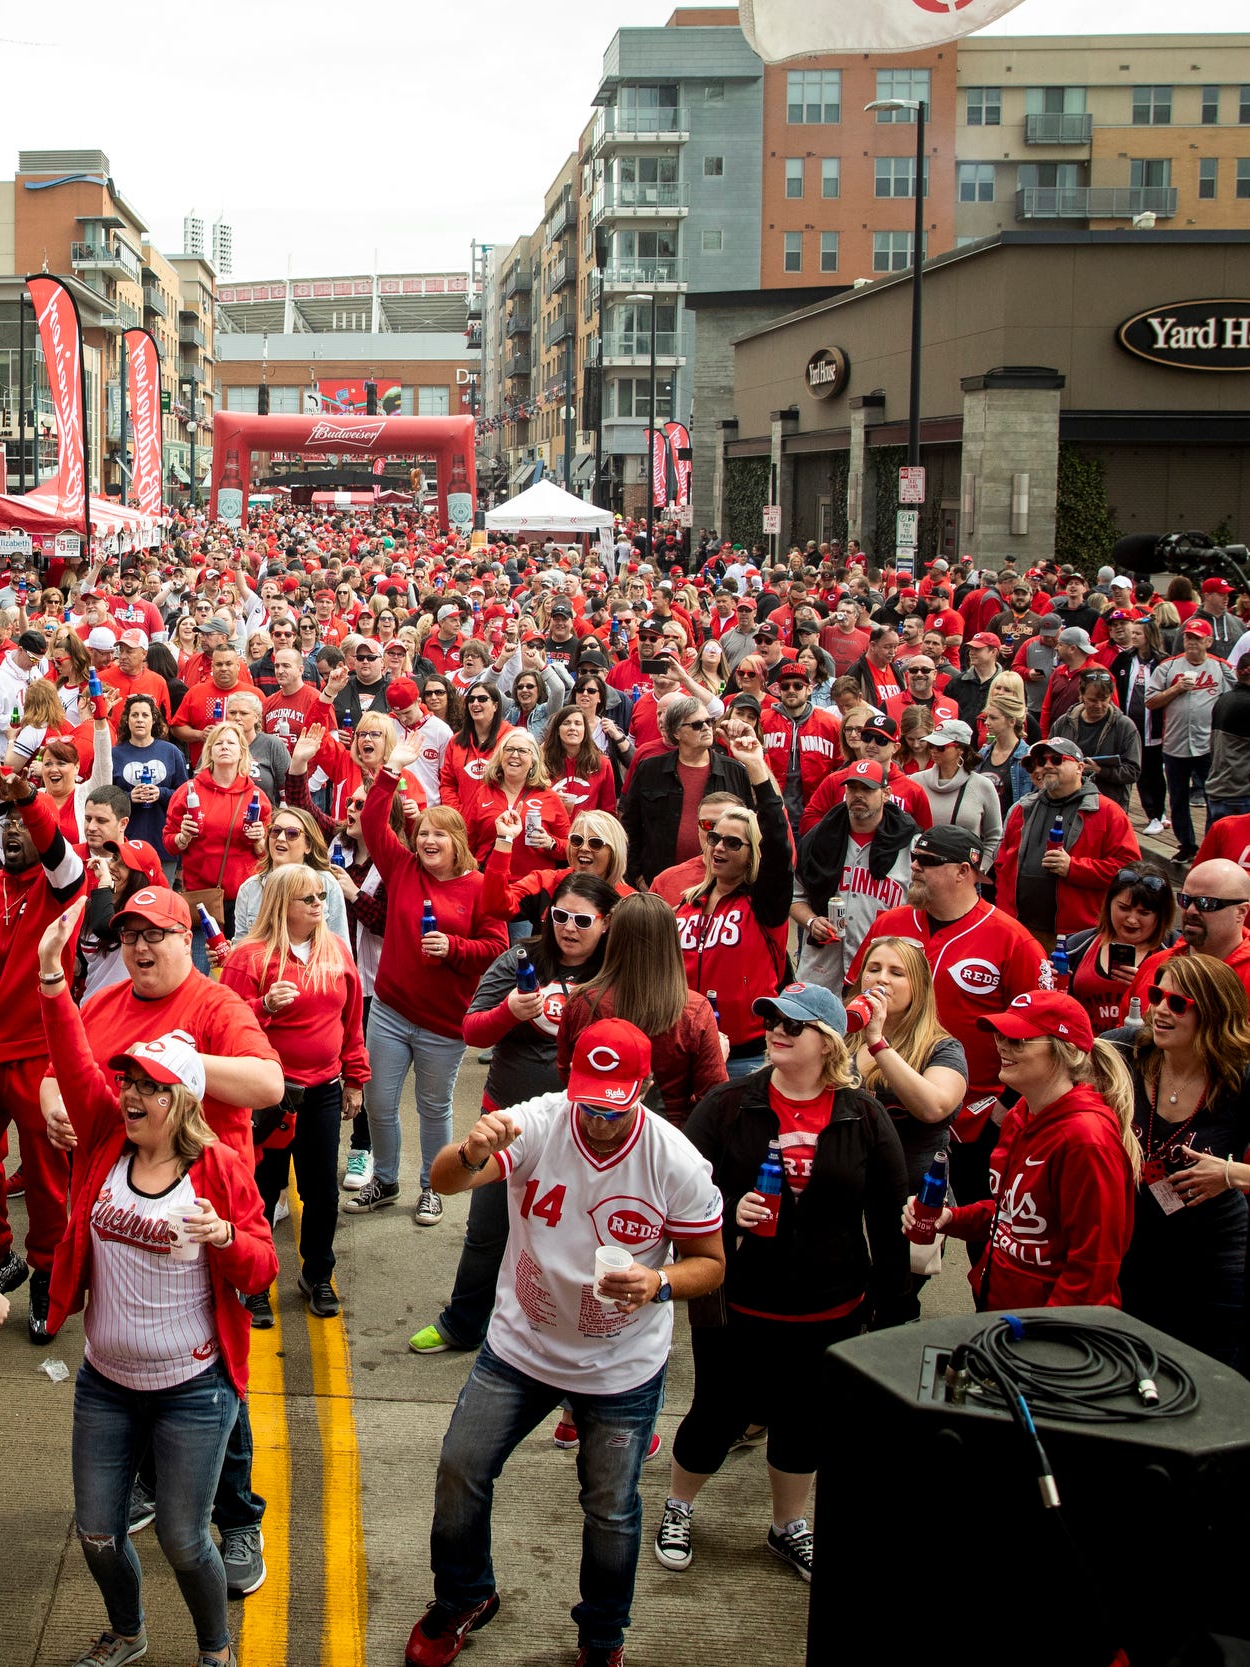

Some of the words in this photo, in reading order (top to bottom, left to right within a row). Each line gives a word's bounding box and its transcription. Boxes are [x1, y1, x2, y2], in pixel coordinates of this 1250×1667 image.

[1147, 317, 1217, 349] Yard
[1221, 317, 1250, 349] H
[809, 361, 821, 385] Yard
[820, 360, 837, 382] House
[131, 338, 162, 516] Budweiser
[313, 425, 378, 441] Budweiser
[549, 651, 571, 660] EDS
[877, 684, 901, 700] RED
[962, 967, 1001, 986] REDS
[1099, 1005, 1120, 1018] NO
[605, 1088, 626, 1099] Reds
[520, 1178, 567, 1228] 14
[610, 1215, 662, 1240] REDS
[992, 1234, 1052, 1267] EBALL
